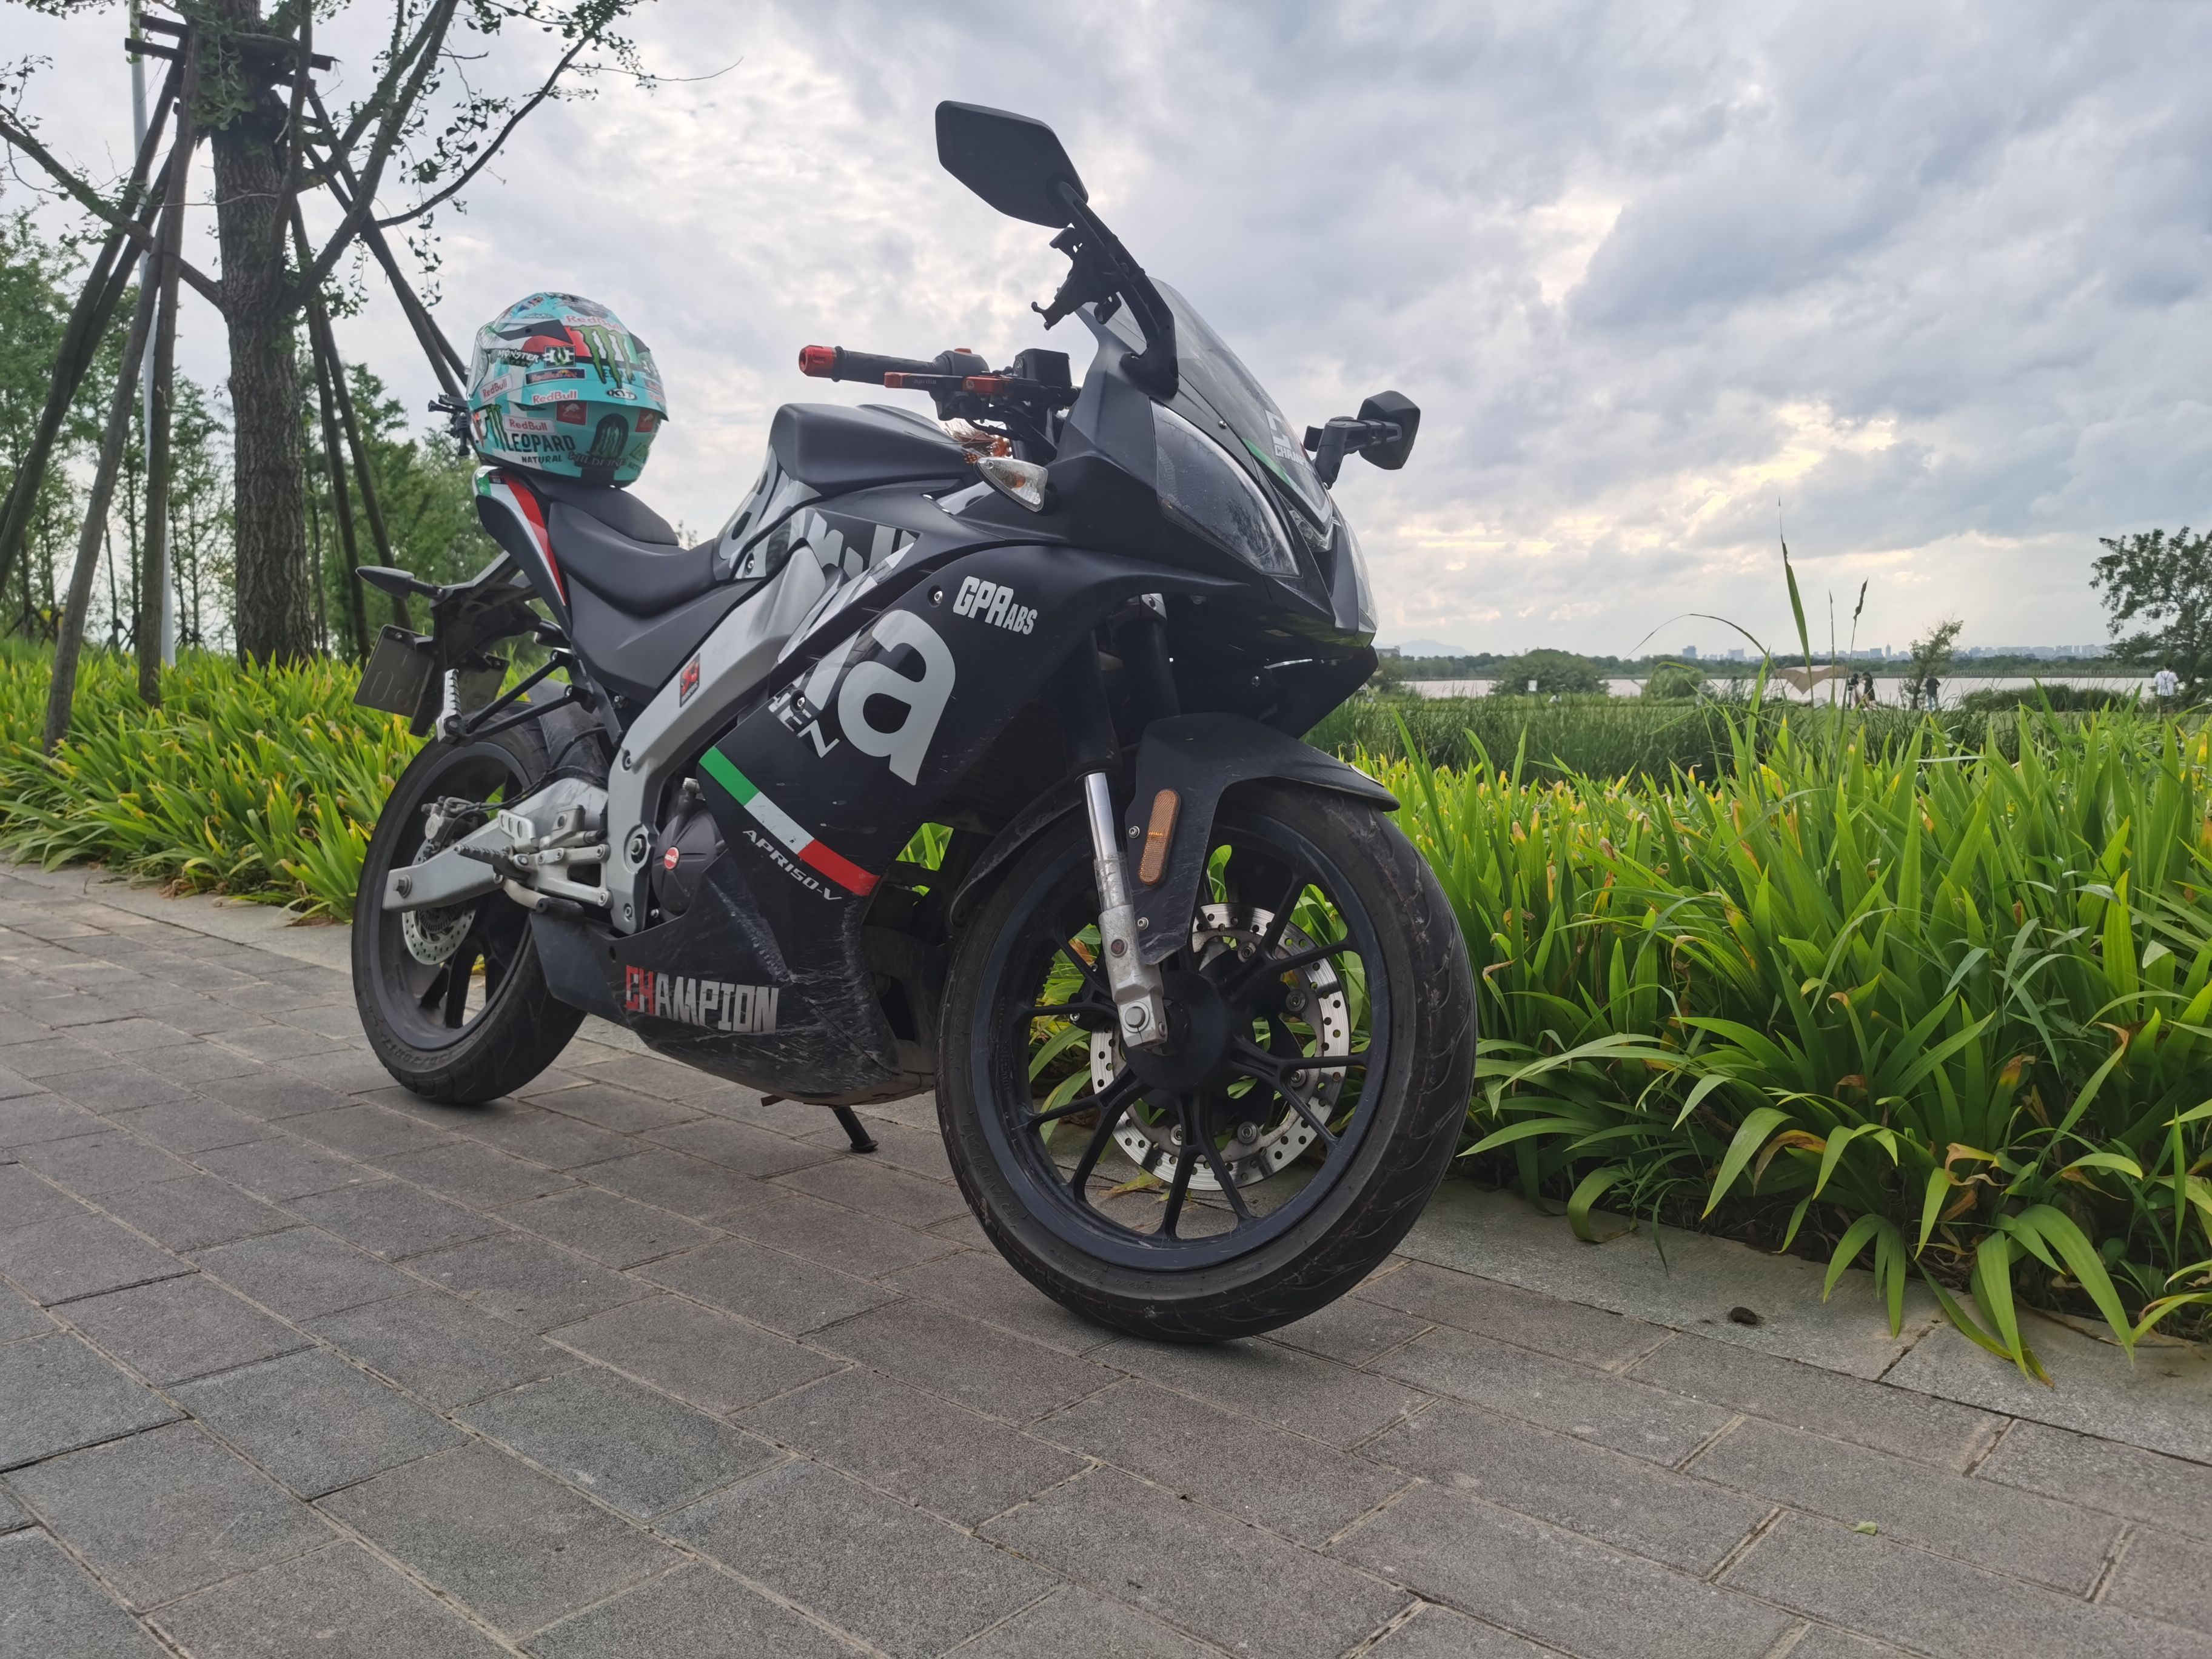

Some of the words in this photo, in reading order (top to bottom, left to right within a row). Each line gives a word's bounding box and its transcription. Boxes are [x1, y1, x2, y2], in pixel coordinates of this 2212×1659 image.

[566, 315, 623, 331] RedBull
[483, 378, 508, 398] RedBull
[533, 390, 577, 404] RedBull
[509, 418, 548, 431] RedBull
[505, 433, 576, 453] LEOPARD
[521, 455, 563, 464] NATURAL
[626, 965, 780, 1034] CHAMPION
